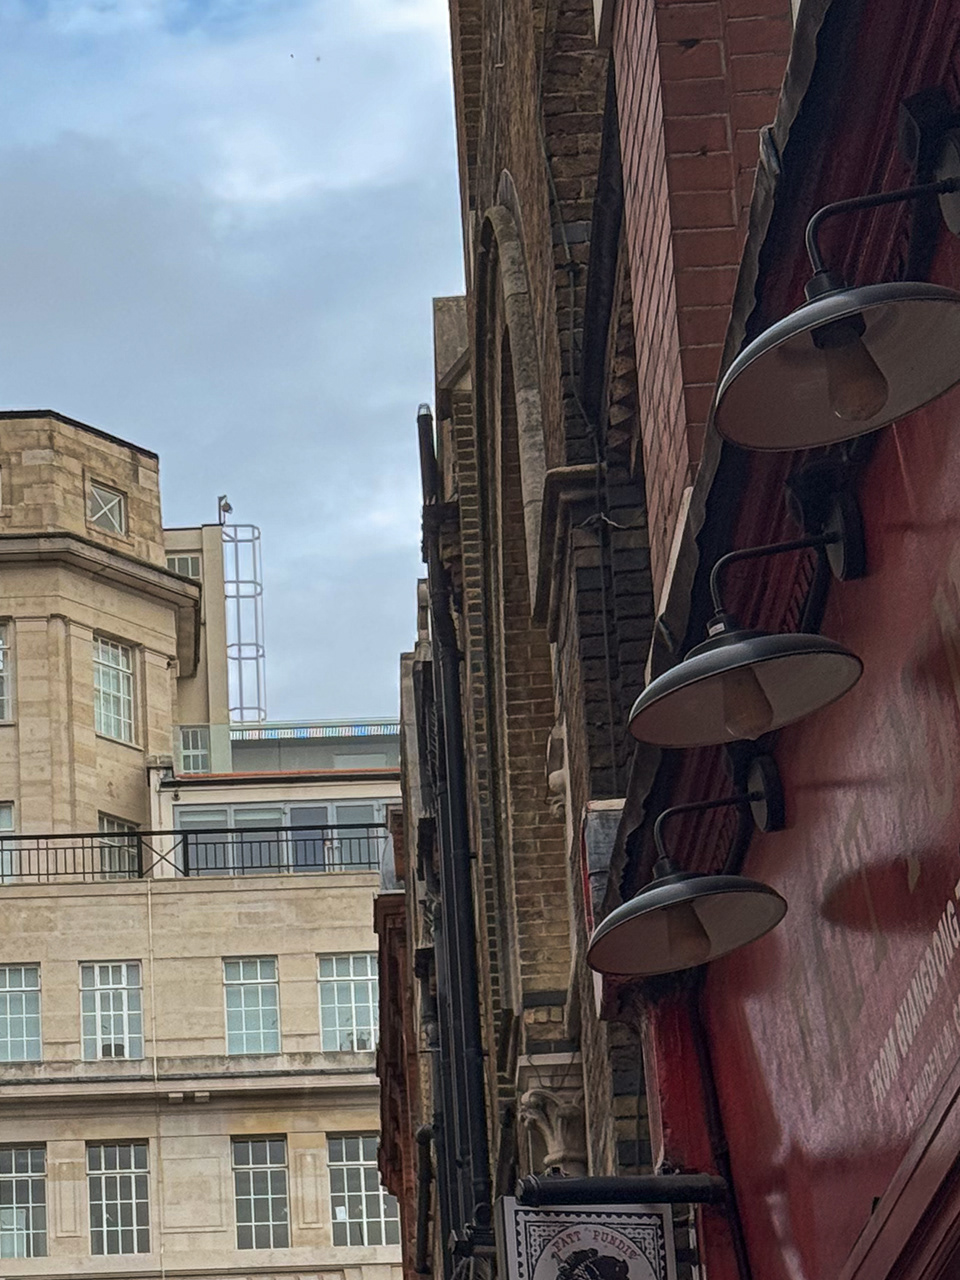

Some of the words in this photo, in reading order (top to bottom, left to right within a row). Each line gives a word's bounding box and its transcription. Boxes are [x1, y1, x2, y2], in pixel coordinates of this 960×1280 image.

[869, 1028, 900, 1112] FROM
[895, 899, 960, 1058] GUANGDONG
[551, 1230, 581, 1253] FATT
